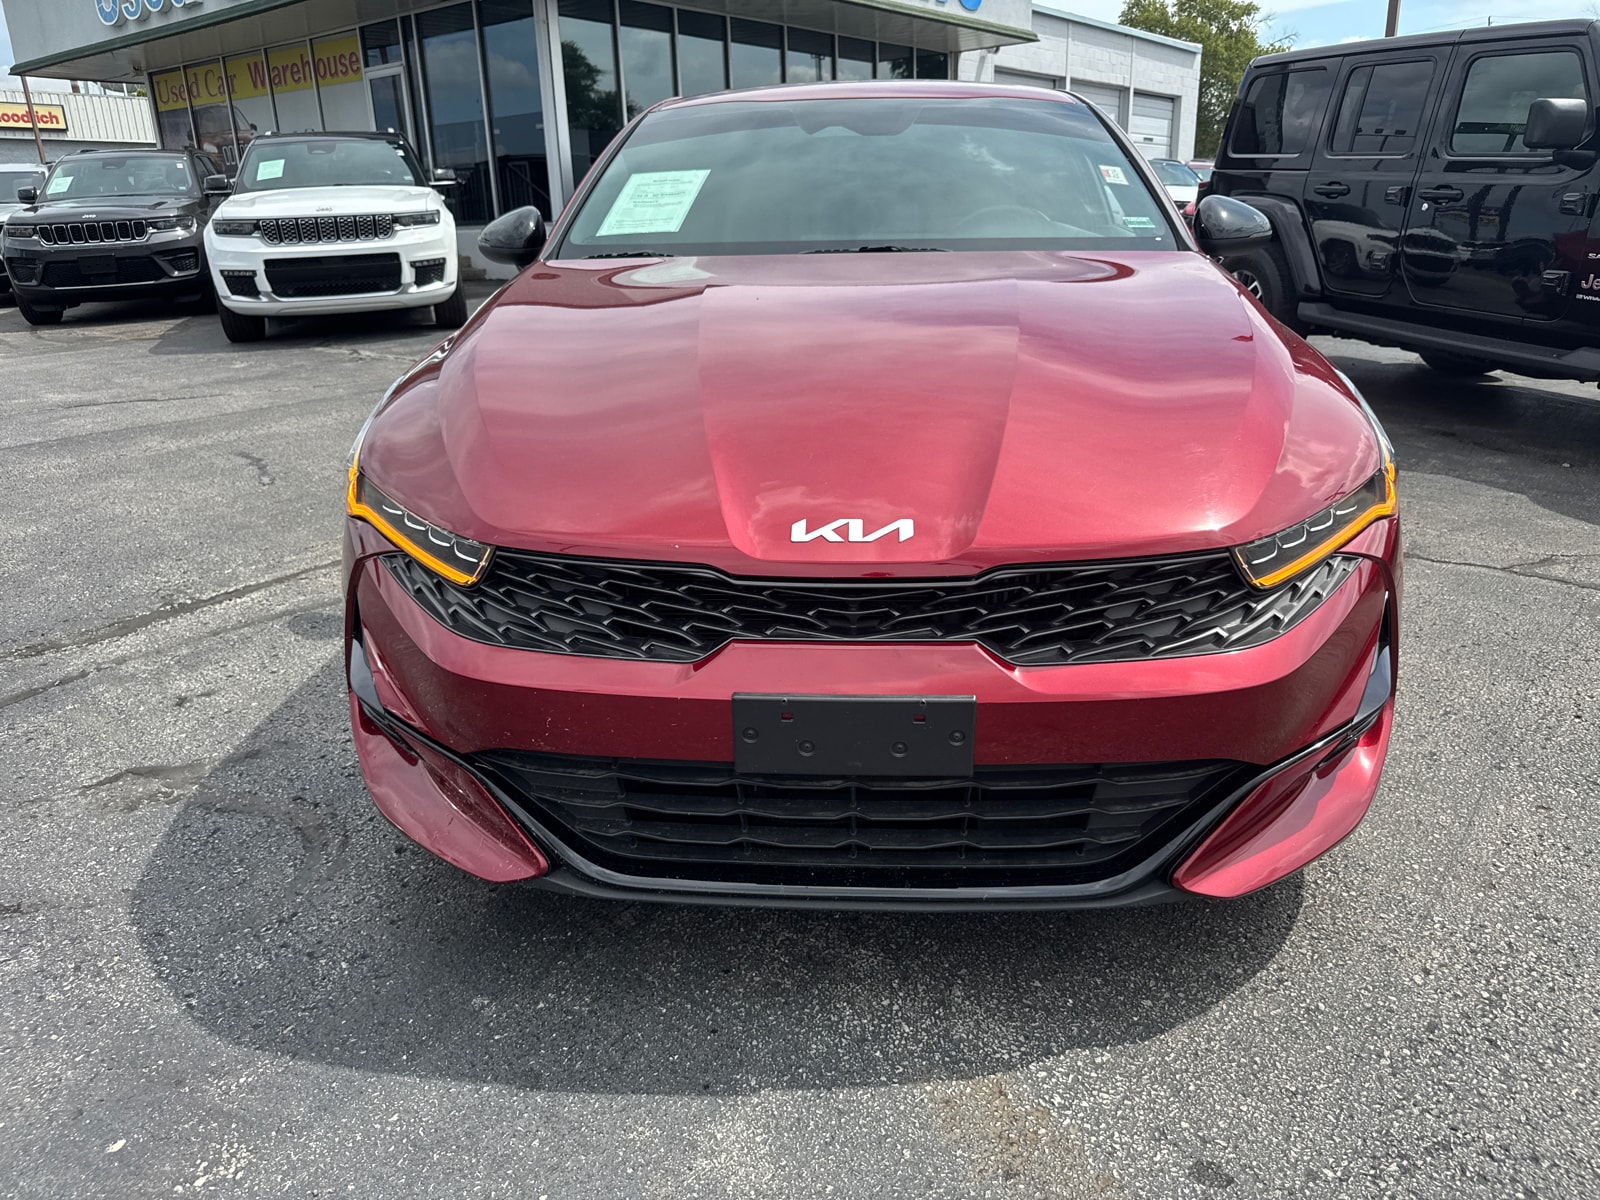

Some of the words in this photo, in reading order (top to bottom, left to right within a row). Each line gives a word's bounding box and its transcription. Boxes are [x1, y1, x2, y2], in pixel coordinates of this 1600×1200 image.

[155, 71, 201, 104] Used
[204, 69, 238, 97] Car
[246, 51, 361, 90] Warehouse
[0, 110, 60, 125] oodich
[791, 518, 915, 543] KIA
